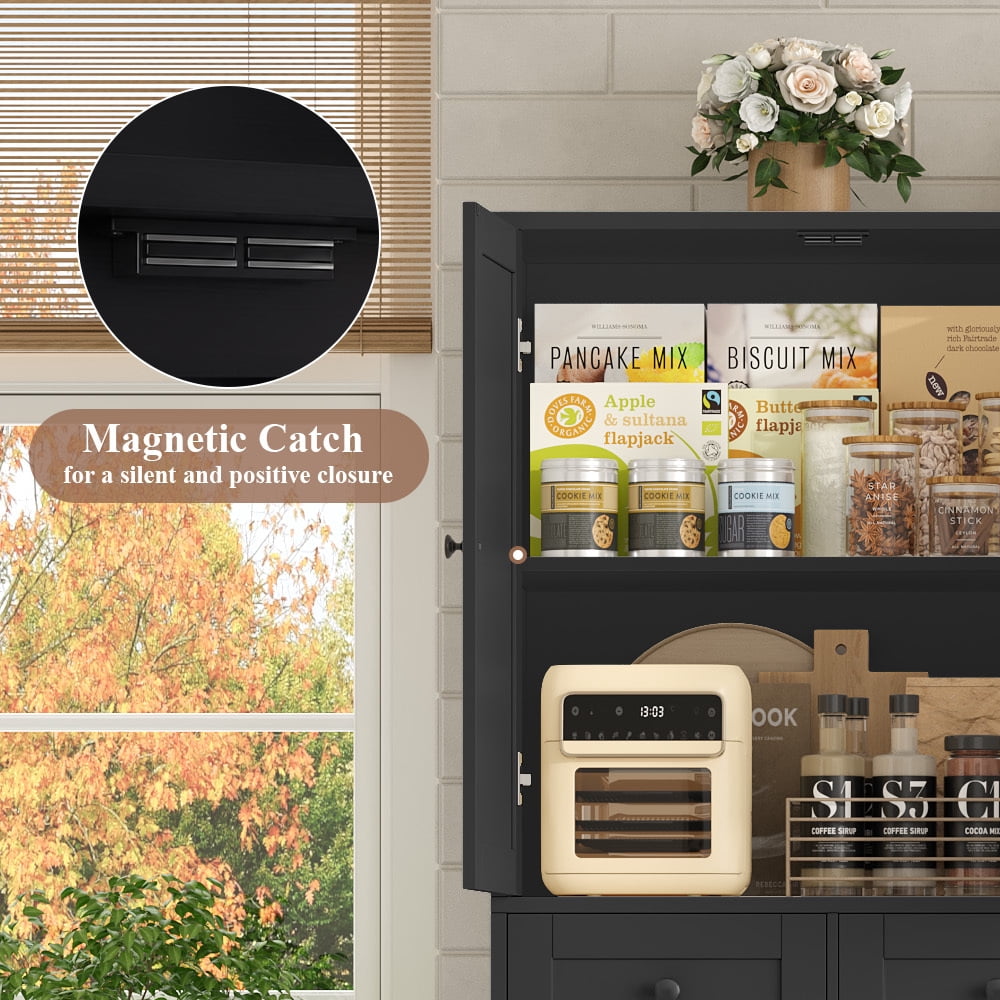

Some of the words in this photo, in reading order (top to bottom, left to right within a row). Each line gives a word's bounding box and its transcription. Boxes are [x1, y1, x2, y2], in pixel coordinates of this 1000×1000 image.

[946, 325, 964, 333] with
[965, 325, 1000, 334] gloriously
[946, 334, 962, 342] rich
[946, 344, 964, 352] dark
[965, 344, 1000, 352] chocolate
[550, 346, 641, 370] PANCAKE
[652, 346, 689, 370] MIX
[727, 346, 810, 370] BISCUIT
[822, 346, 857, 370] MIX
[927, 375, 945, 398] new
[604, 394, 656, 411] Apple
[756, 400, 800, 414] Butte
[604, 413, 618, 426] &
[623, 413, 688, 427] sultana
[552, 416, 593, 437] ORGANIC
[604, 432, 674, 449] flapjack
[868, 482, 896, 490] STAR
[556, 492, 587, 500] COOKIE
[588, 492, 602, 500] MIX
[644, 492, 674, 500] COOKIE
[676, 492, 690, 500] MIX
[733, 492, 765, 500] COOKIE
[766, 492, 780, 500] MIX
[865, 493, 899, 501] ANISE
[938, 506, 994, 515] CINNAMON
[949, 517, 983, 525] STICK
[640, 705, 665, 718] 13:03
[751, 707, 798, 727] OOK
[811, 780, 852, 819] S1
[881, 780, 929, 819] S3
[957, 779, 1000, 819] C1
[811, 827, 837, 835] COFFEE
[838, 827, 857, 835] SIRUP
[883, 827, 908, 835] COFFEE
[909, 827, 929, 835] SIRUP
[964, 827, 989, 835] COCOA
[989, 827, 1000, 835] MIX
